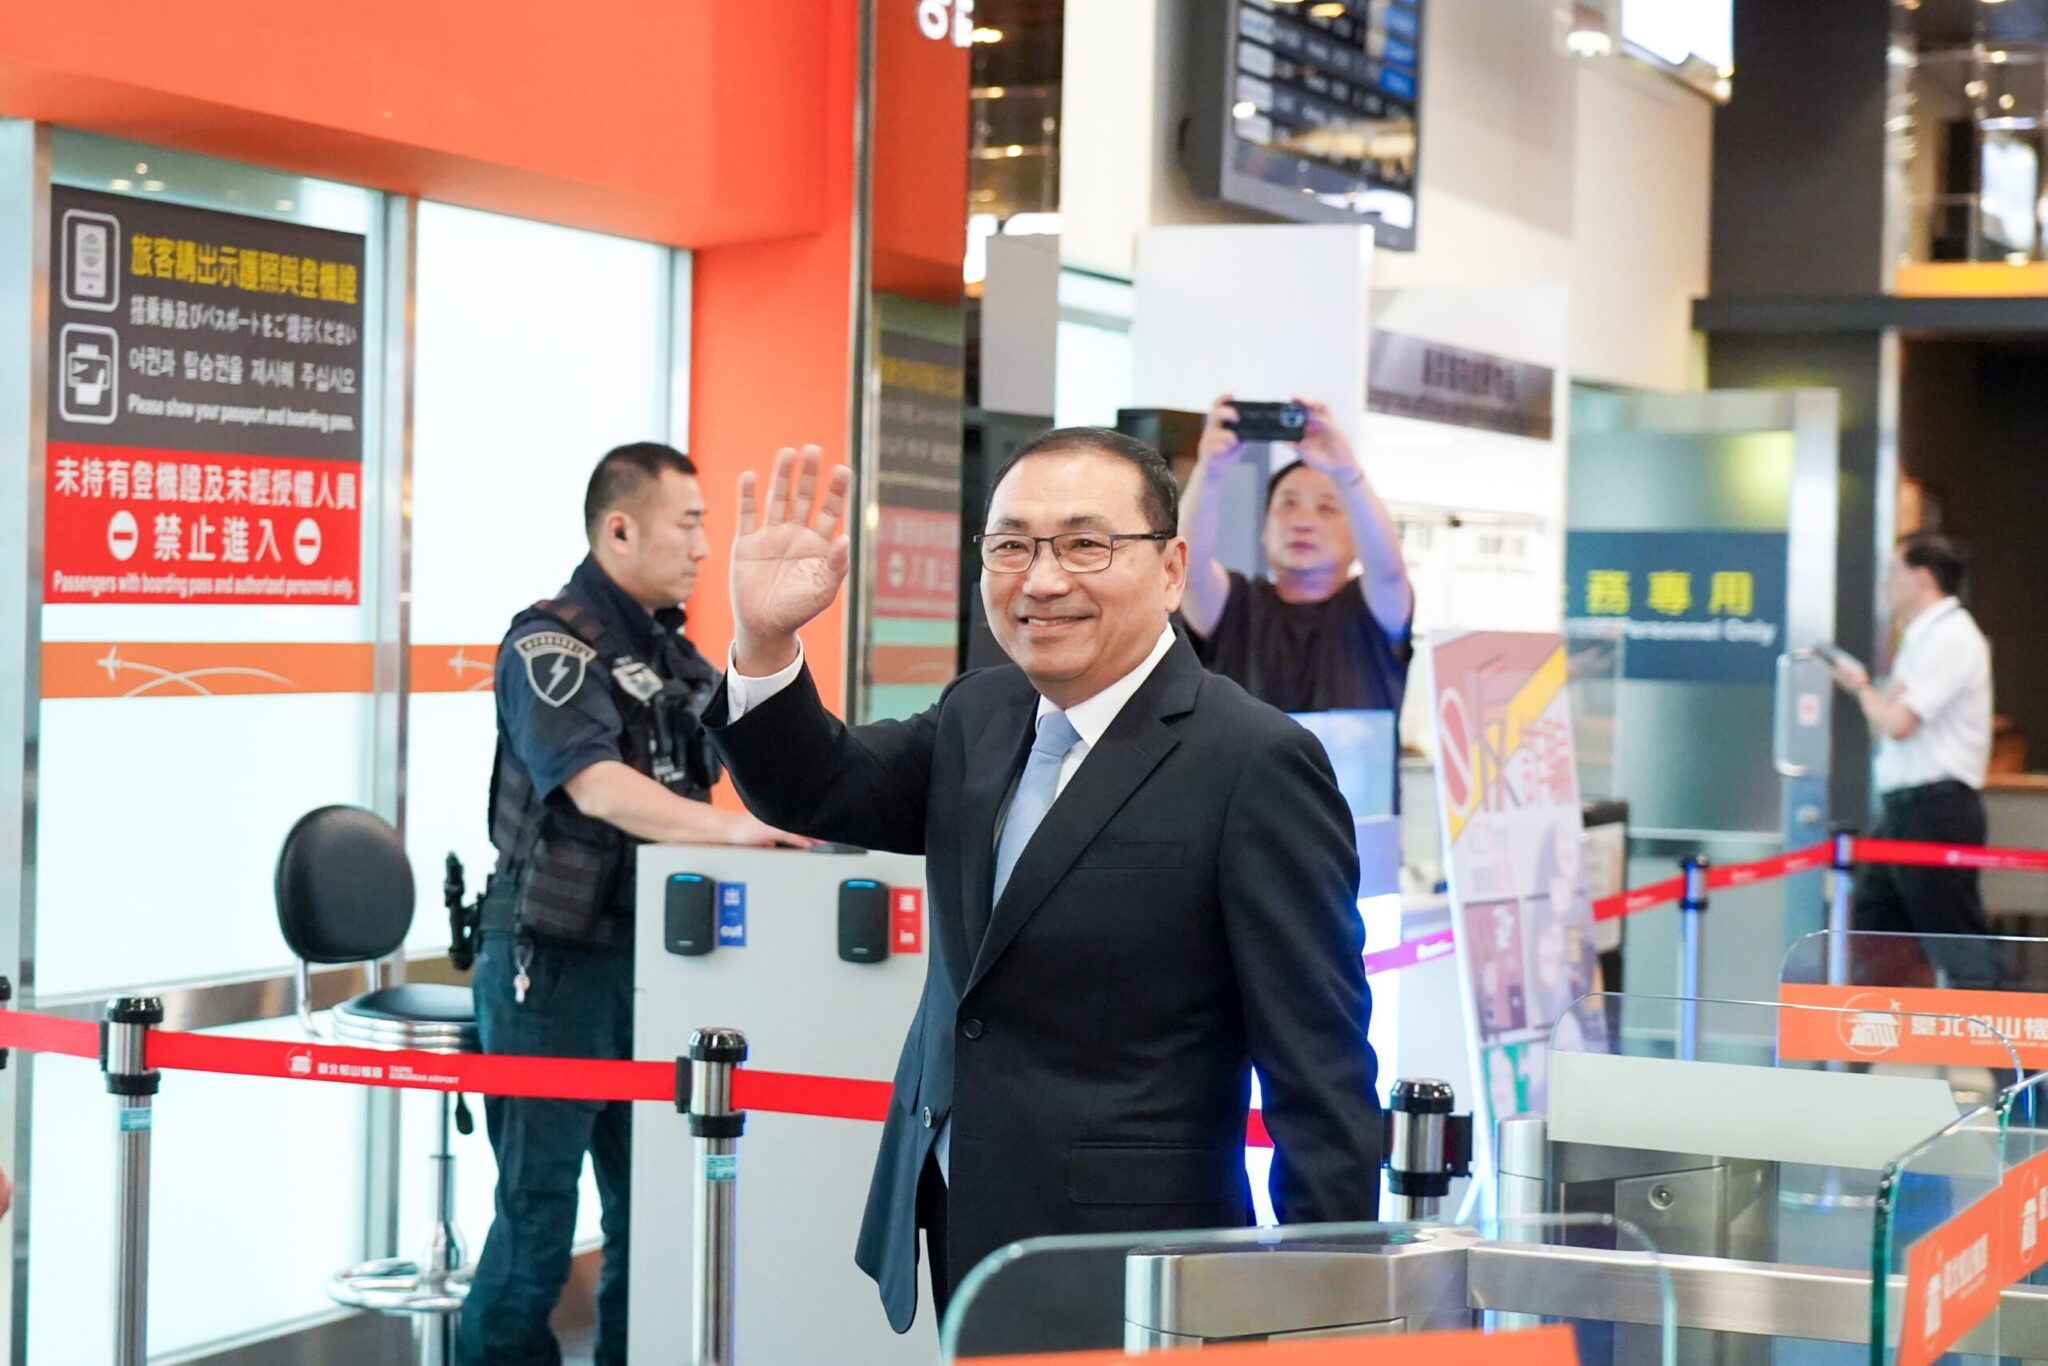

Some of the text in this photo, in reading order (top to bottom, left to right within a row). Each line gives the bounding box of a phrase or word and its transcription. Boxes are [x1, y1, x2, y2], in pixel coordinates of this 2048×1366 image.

[55, 456, 356, 510] 未持有登機證及未經授權人員
[153, 512, 282, 563] 禁止進入
[53, 570, 116, 598] Passengers
[118, 572, 139, 593] with
[1562, 569, 1753, 616] 務專用
[720, 924, 744, 939] out
